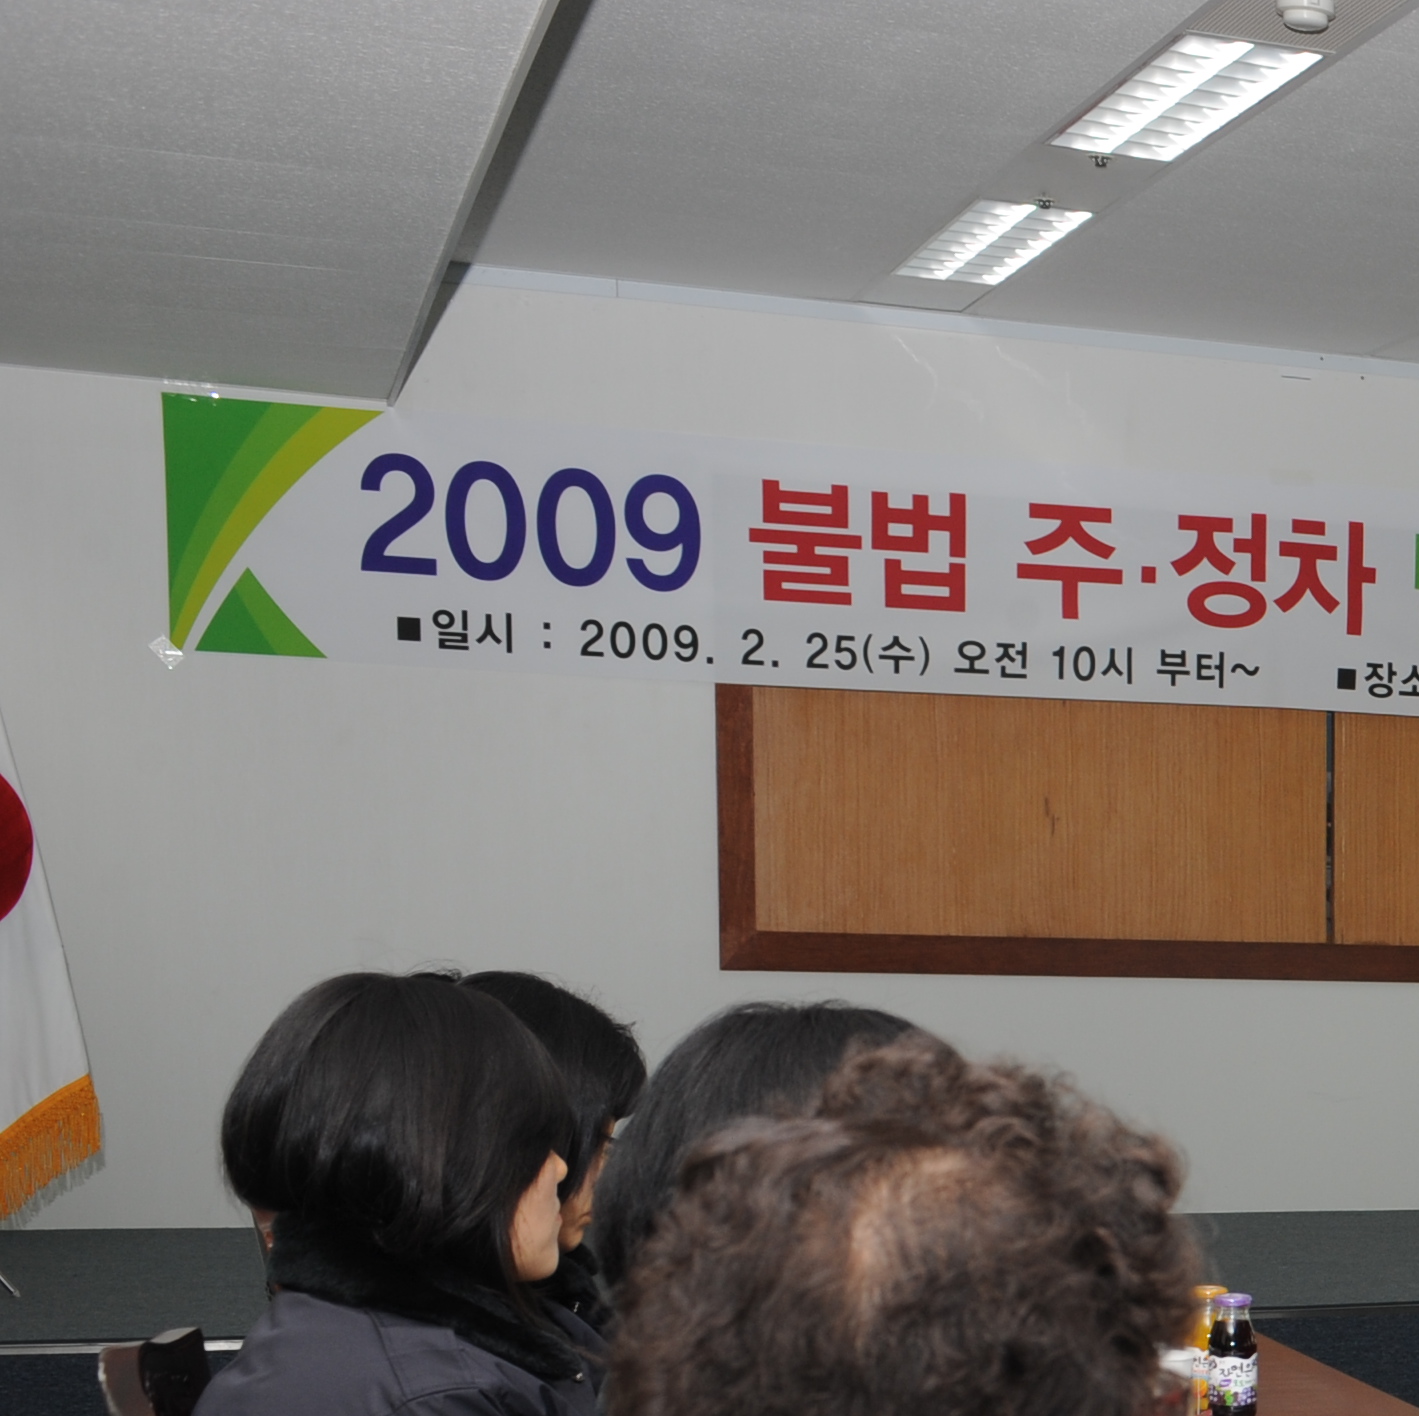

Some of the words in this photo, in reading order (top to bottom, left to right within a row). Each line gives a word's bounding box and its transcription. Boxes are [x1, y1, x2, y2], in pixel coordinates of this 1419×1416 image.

[360, 453, 701, 592] 2009
[749, 478, 966, 612] 불법
[431, 609, 513, 654] 일시
[580, 619, 714, 665] 2009.
[741, 628, 779, 668] 2.
[806, 632, 930, 676] 25(수)
[953, 640, 1029, 681] 오전
[1052, 645, 1133, 685] 10시
